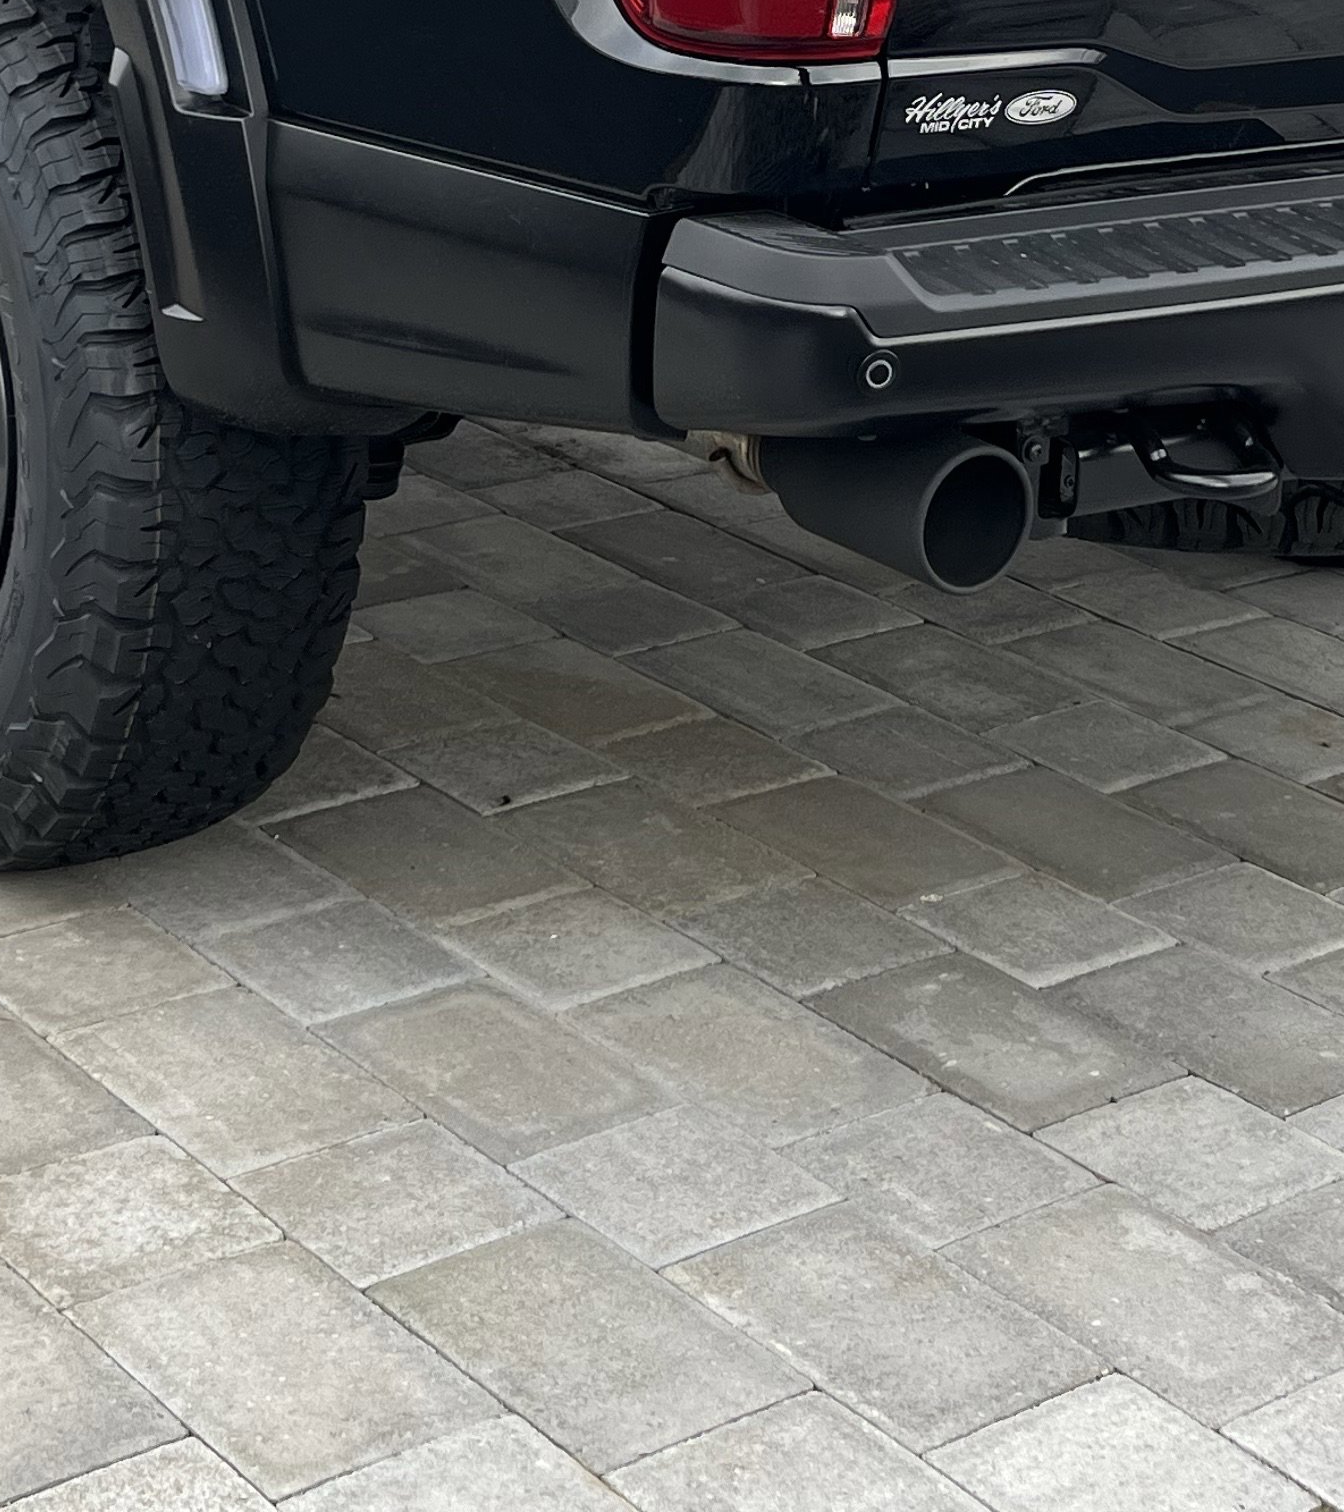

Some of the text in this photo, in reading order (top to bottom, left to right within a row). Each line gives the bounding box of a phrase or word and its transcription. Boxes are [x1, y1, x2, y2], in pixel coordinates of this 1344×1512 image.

[905, 92, 1063, 133] Hillyer's Ford
[920, 116, 994, 134] MID CITY
